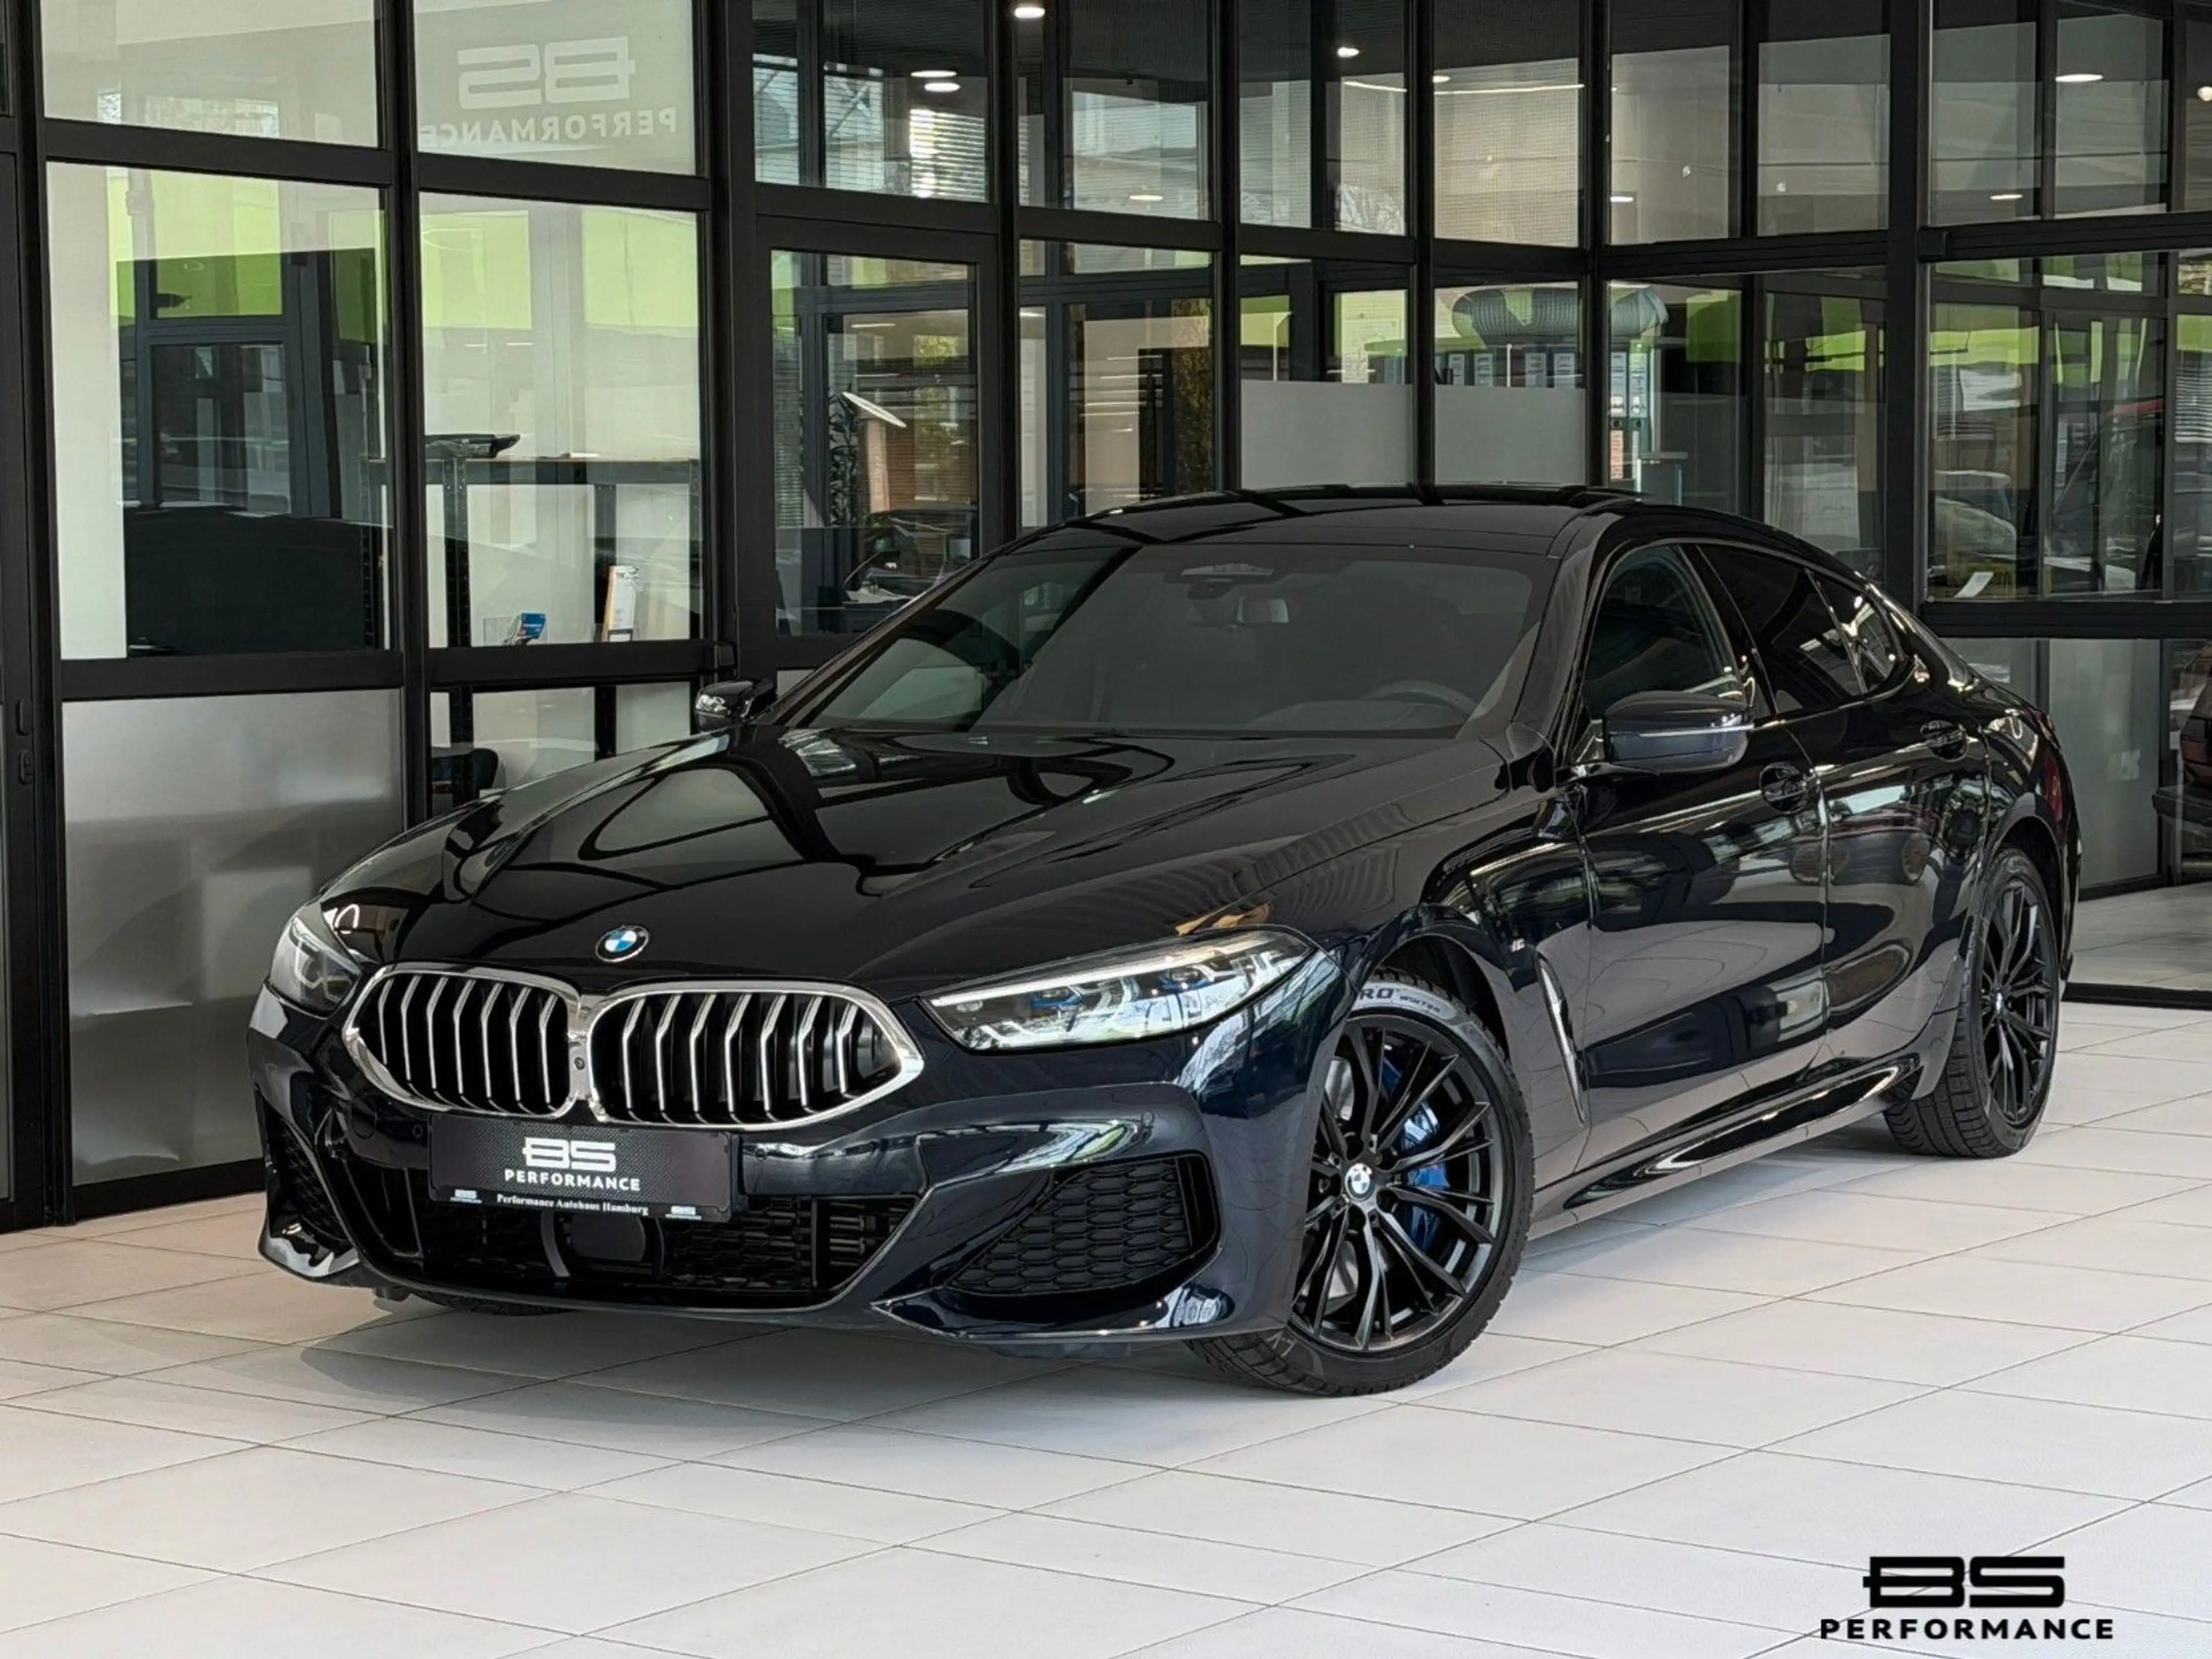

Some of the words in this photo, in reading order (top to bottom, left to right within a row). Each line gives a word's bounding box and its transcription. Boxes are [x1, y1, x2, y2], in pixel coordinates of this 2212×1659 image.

[522, 1137, 617, 1172] BS
[504, 1168, 641, 1192] PERFORMANCE
[497, 1193, 555, 1207] Performance
[555, 1199, 600, 1211] Autohaus
[603, 1202, 649, 1217] Hamburg
